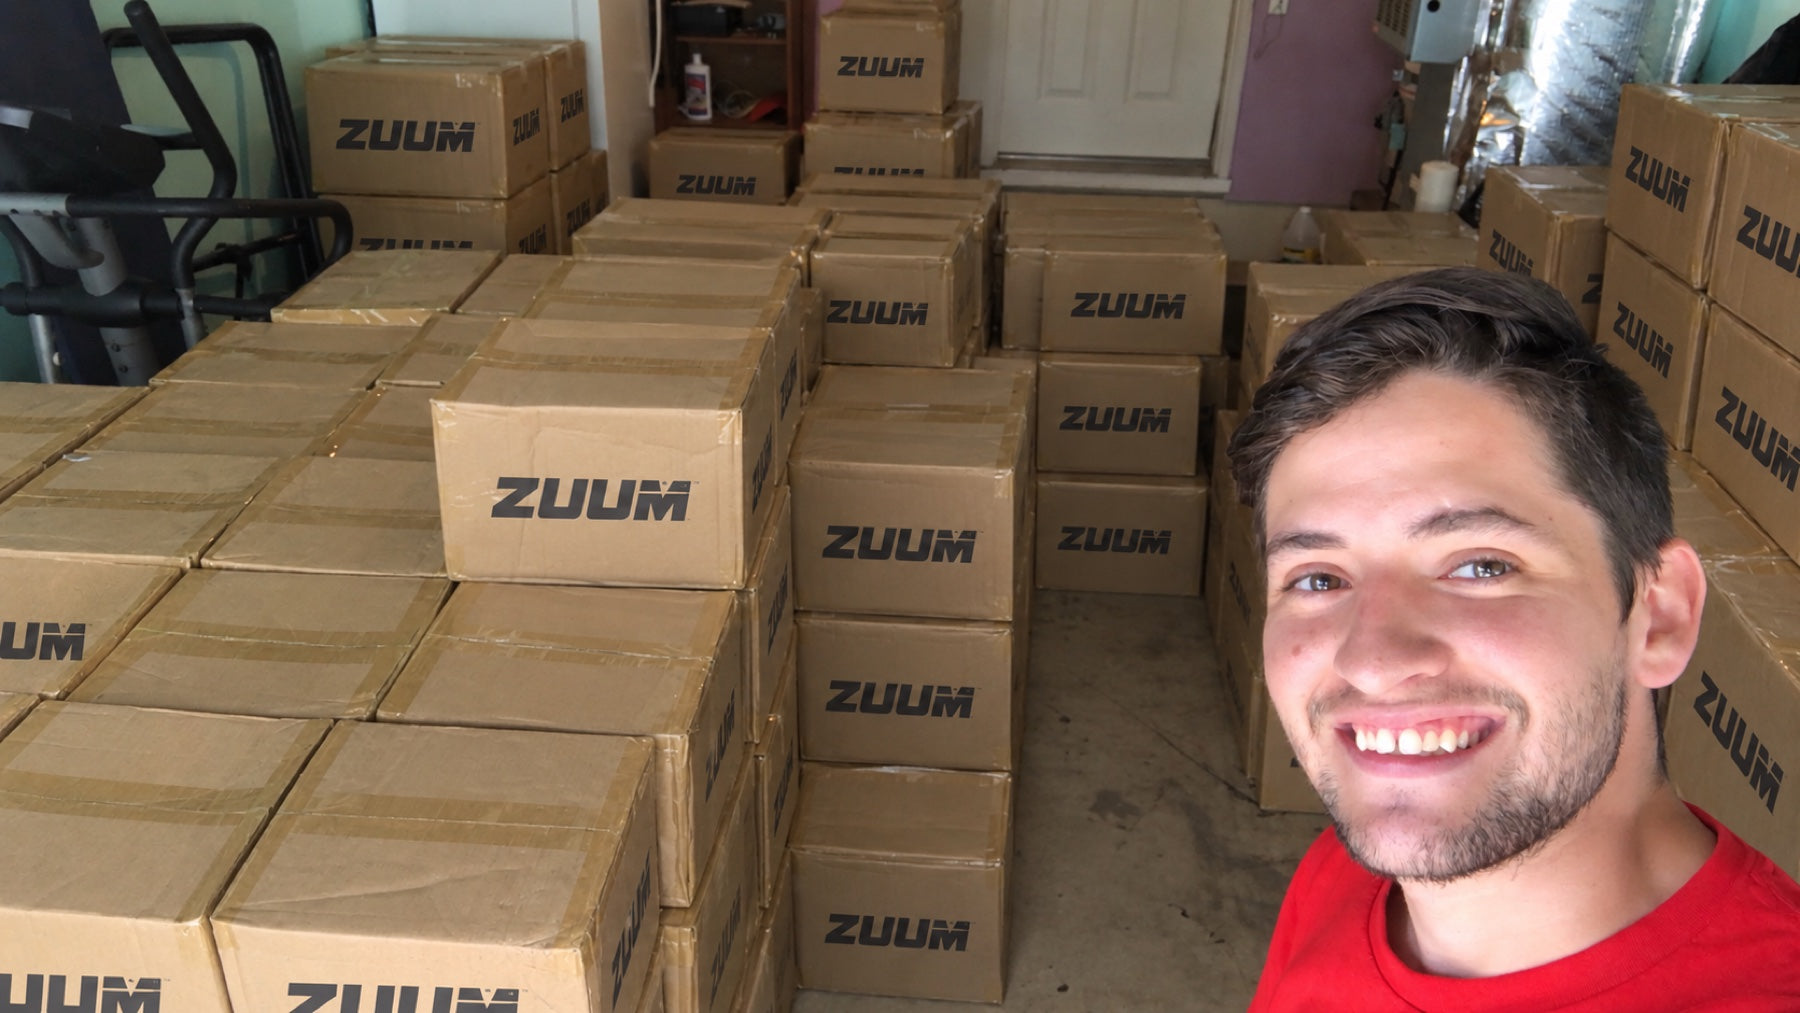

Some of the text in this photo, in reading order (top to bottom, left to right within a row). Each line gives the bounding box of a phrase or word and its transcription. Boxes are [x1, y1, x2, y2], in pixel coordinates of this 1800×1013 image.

[837, 56, 924, 78] ZUUM
[561, 89, 584, 123] ZUUM
[336, 119, 475, 153] ZUUM
[513, 108, 540, 146] ZUUM
[676, 174, 757, 196] ZUUM
[1625, 146, 1691, 213] ZUUM
[1737, 205, 1800, 278] ZUU
[827, 300, 929, 326] ZUUM
[1071, 292, 1187, 320] ZUUM
[1613, 301, 1674, 379] ZUUM
[1060, 406, 1172, 433] ZUUM
[1715, 385, 1800, 492] ZUUM
[491, 476, 691, 521] ZUUM
[822, 525, 977, 564] ZUUM
[1057, 526, 1172, 555] ZUUM
[825, 680, 975, 719] ZUUM
[1694, 670, 1784, 816] ZUUM
[612, 850, 651, 1011] ZUUM
[824, 913, 971, 952] ZUUM
